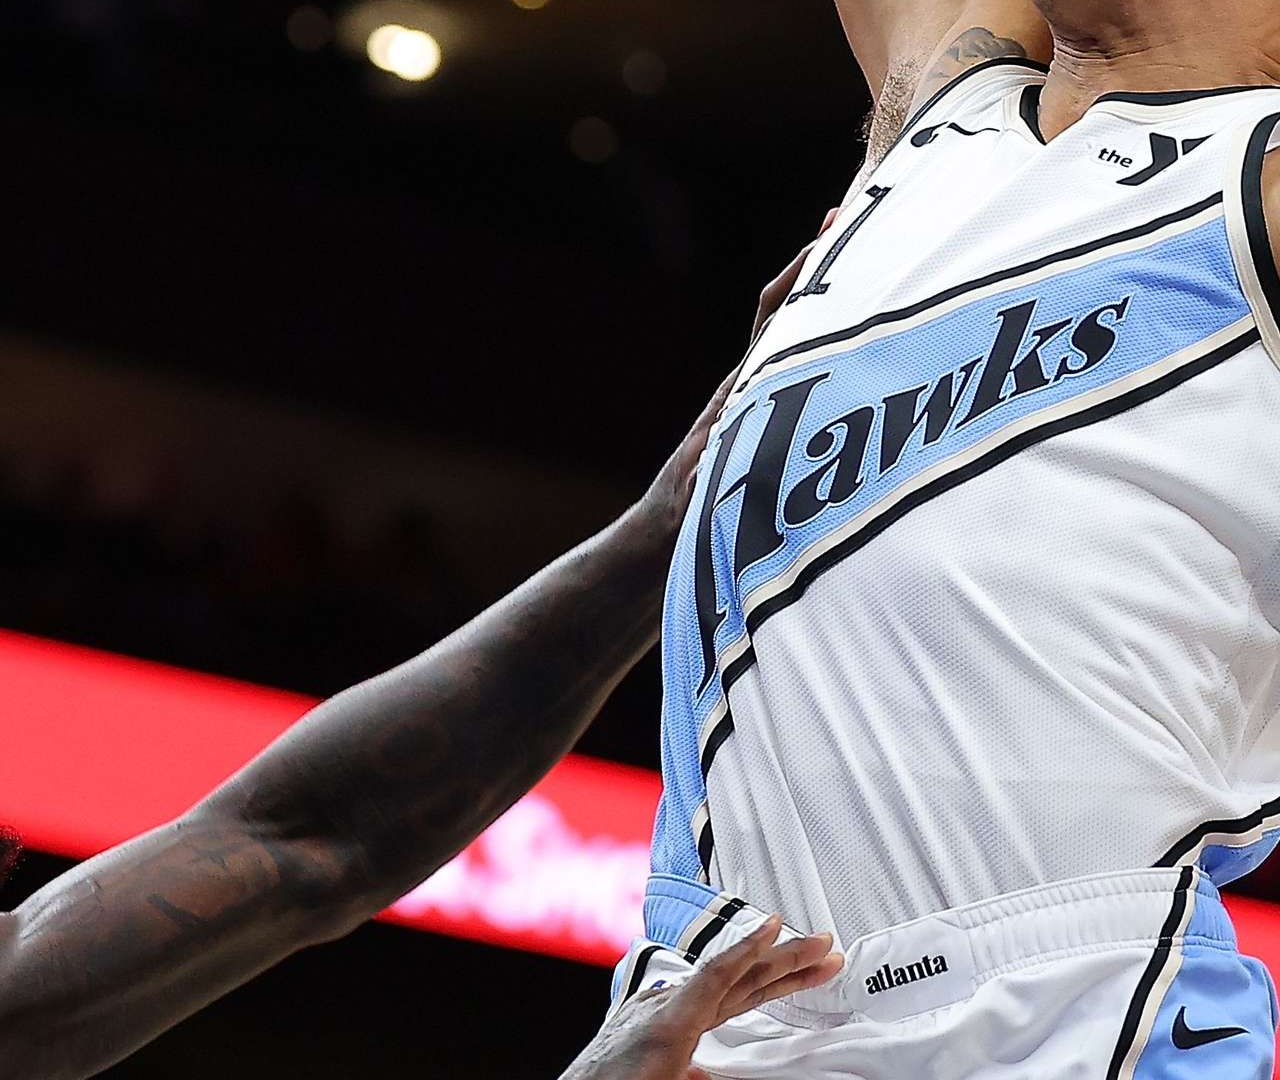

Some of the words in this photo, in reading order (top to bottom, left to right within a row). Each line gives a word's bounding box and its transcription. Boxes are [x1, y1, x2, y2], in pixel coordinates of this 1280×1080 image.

[1098, 147, 1133, 169] the
[785, 184, 893, 307] 1
[694, 295, 1132, 700] Hawks
[864, 952, 950, 996] atlanta
